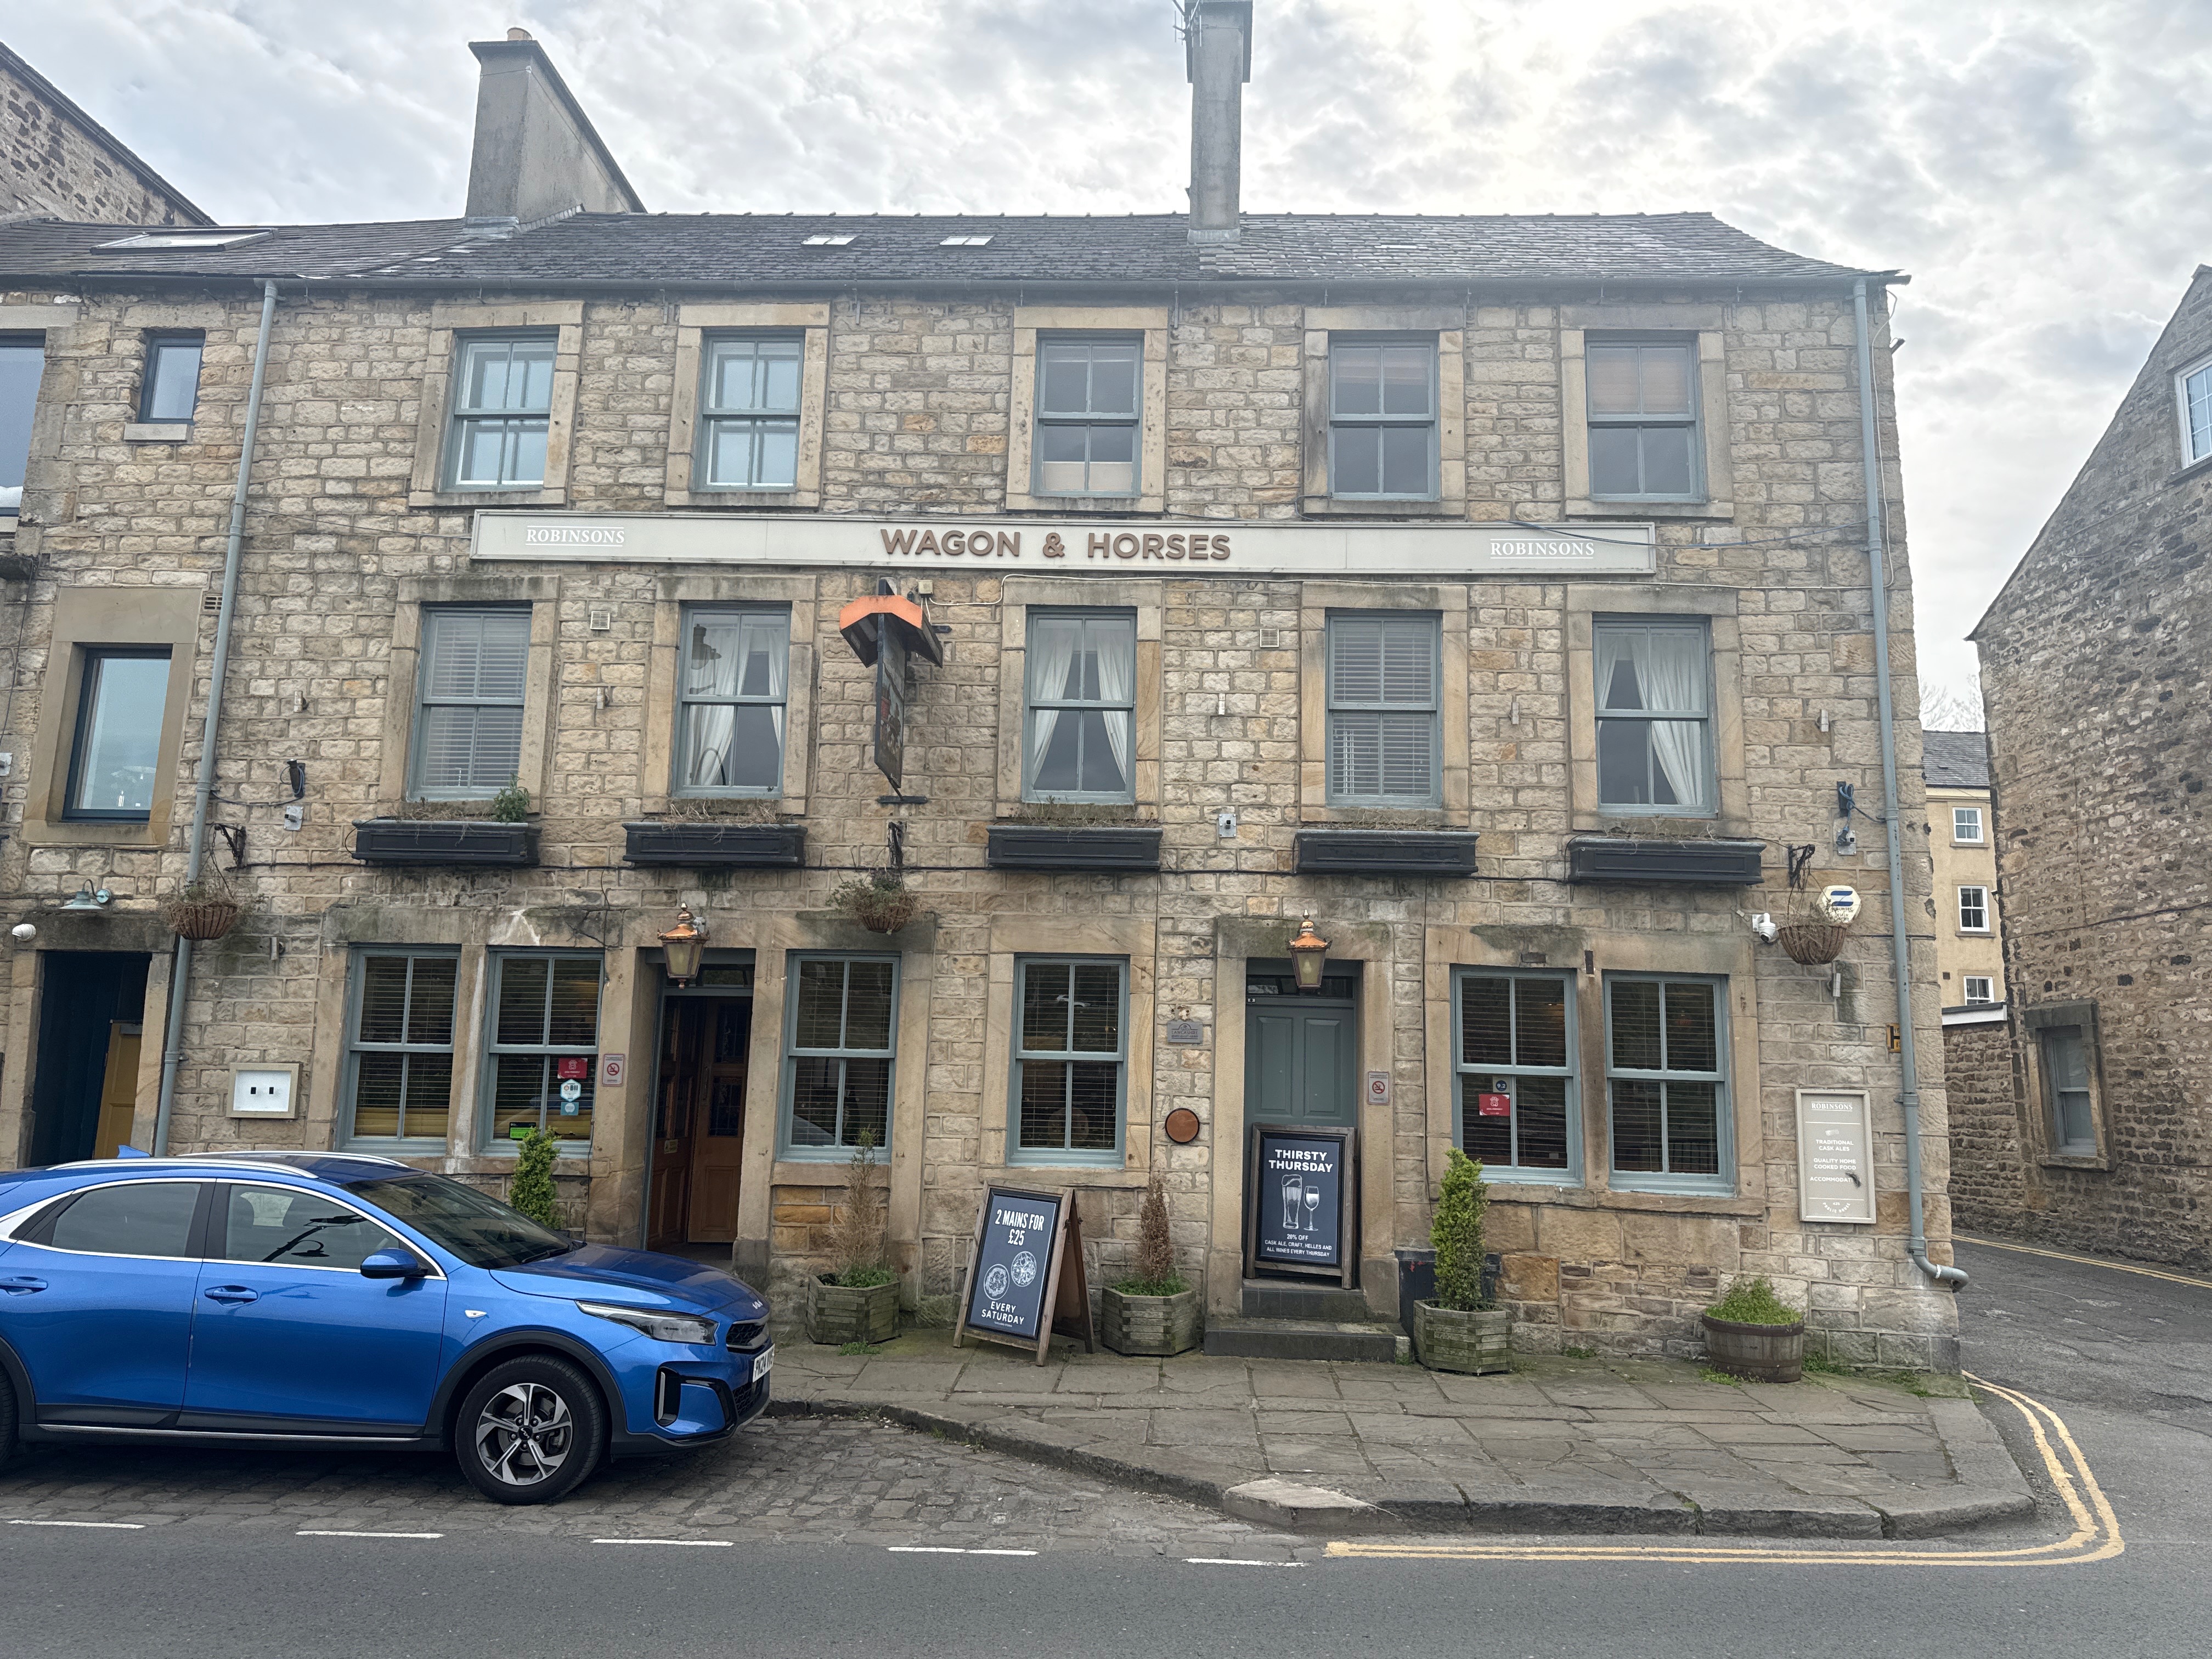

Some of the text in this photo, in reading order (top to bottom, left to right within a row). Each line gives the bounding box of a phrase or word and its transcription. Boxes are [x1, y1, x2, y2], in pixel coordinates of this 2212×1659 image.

[526, 529, 625, 544] ROBINSONS
[881, 529, 1231, 560] WAGON & HORSES
[1490, 542, 1595, 556] ROBINSONS
[1274, 1149, 1328, 1161] THIRSTY
[1268, 1159, 1334, 1173] THURSDAY
[995, 1209, 1045, 1231] 2 MAINS FOR
[1007, 1228, 1025, 1246] £25
[990, 1301, 1017, 1313] EVERY
[981, 1309, 1025, 1325] SATURDAY
